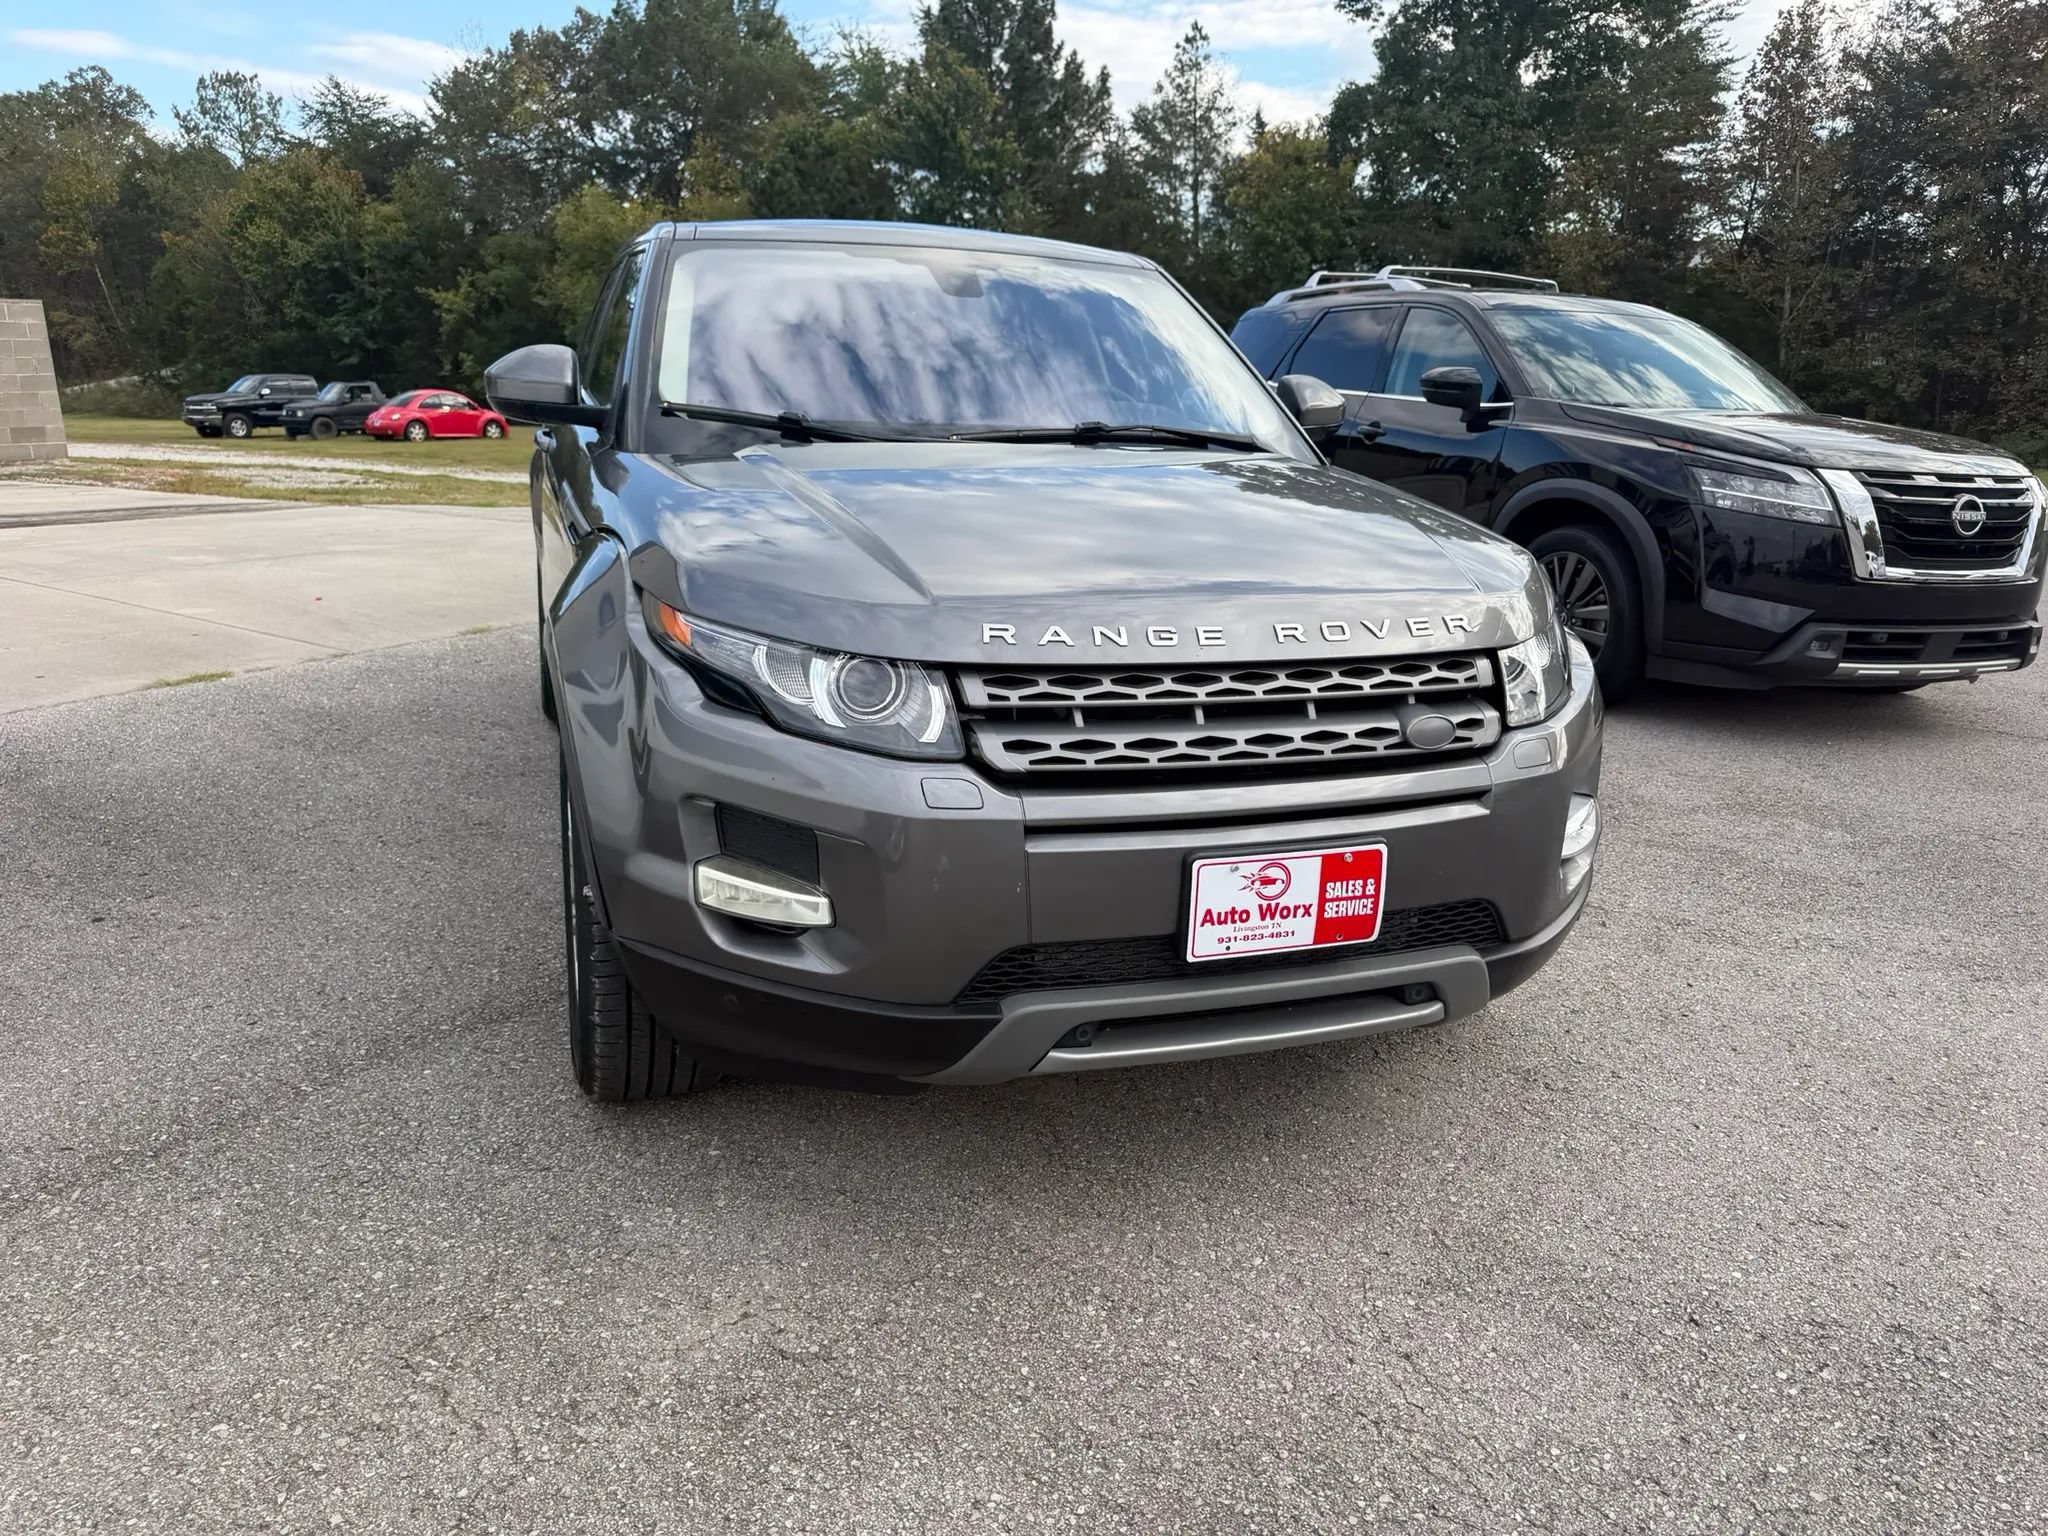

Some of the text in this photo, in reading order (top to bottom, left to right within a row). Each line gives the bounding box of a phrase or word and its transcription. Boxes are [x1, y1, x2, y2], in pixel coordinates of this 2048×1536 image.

[1952, 511, 1986, 520] NISSAN
[982, 613, 1473, 647] RANGE ROVER
[1325, 878, 1376, 898] SALES &
[1200, 901, 1314, 927] Auto Worx
[1324, 898, 1375, 918] SERVICE
[1233, 921, 1282, 932] Livingston TN
[1217, 930, 1295, 945] 931-823-4831
